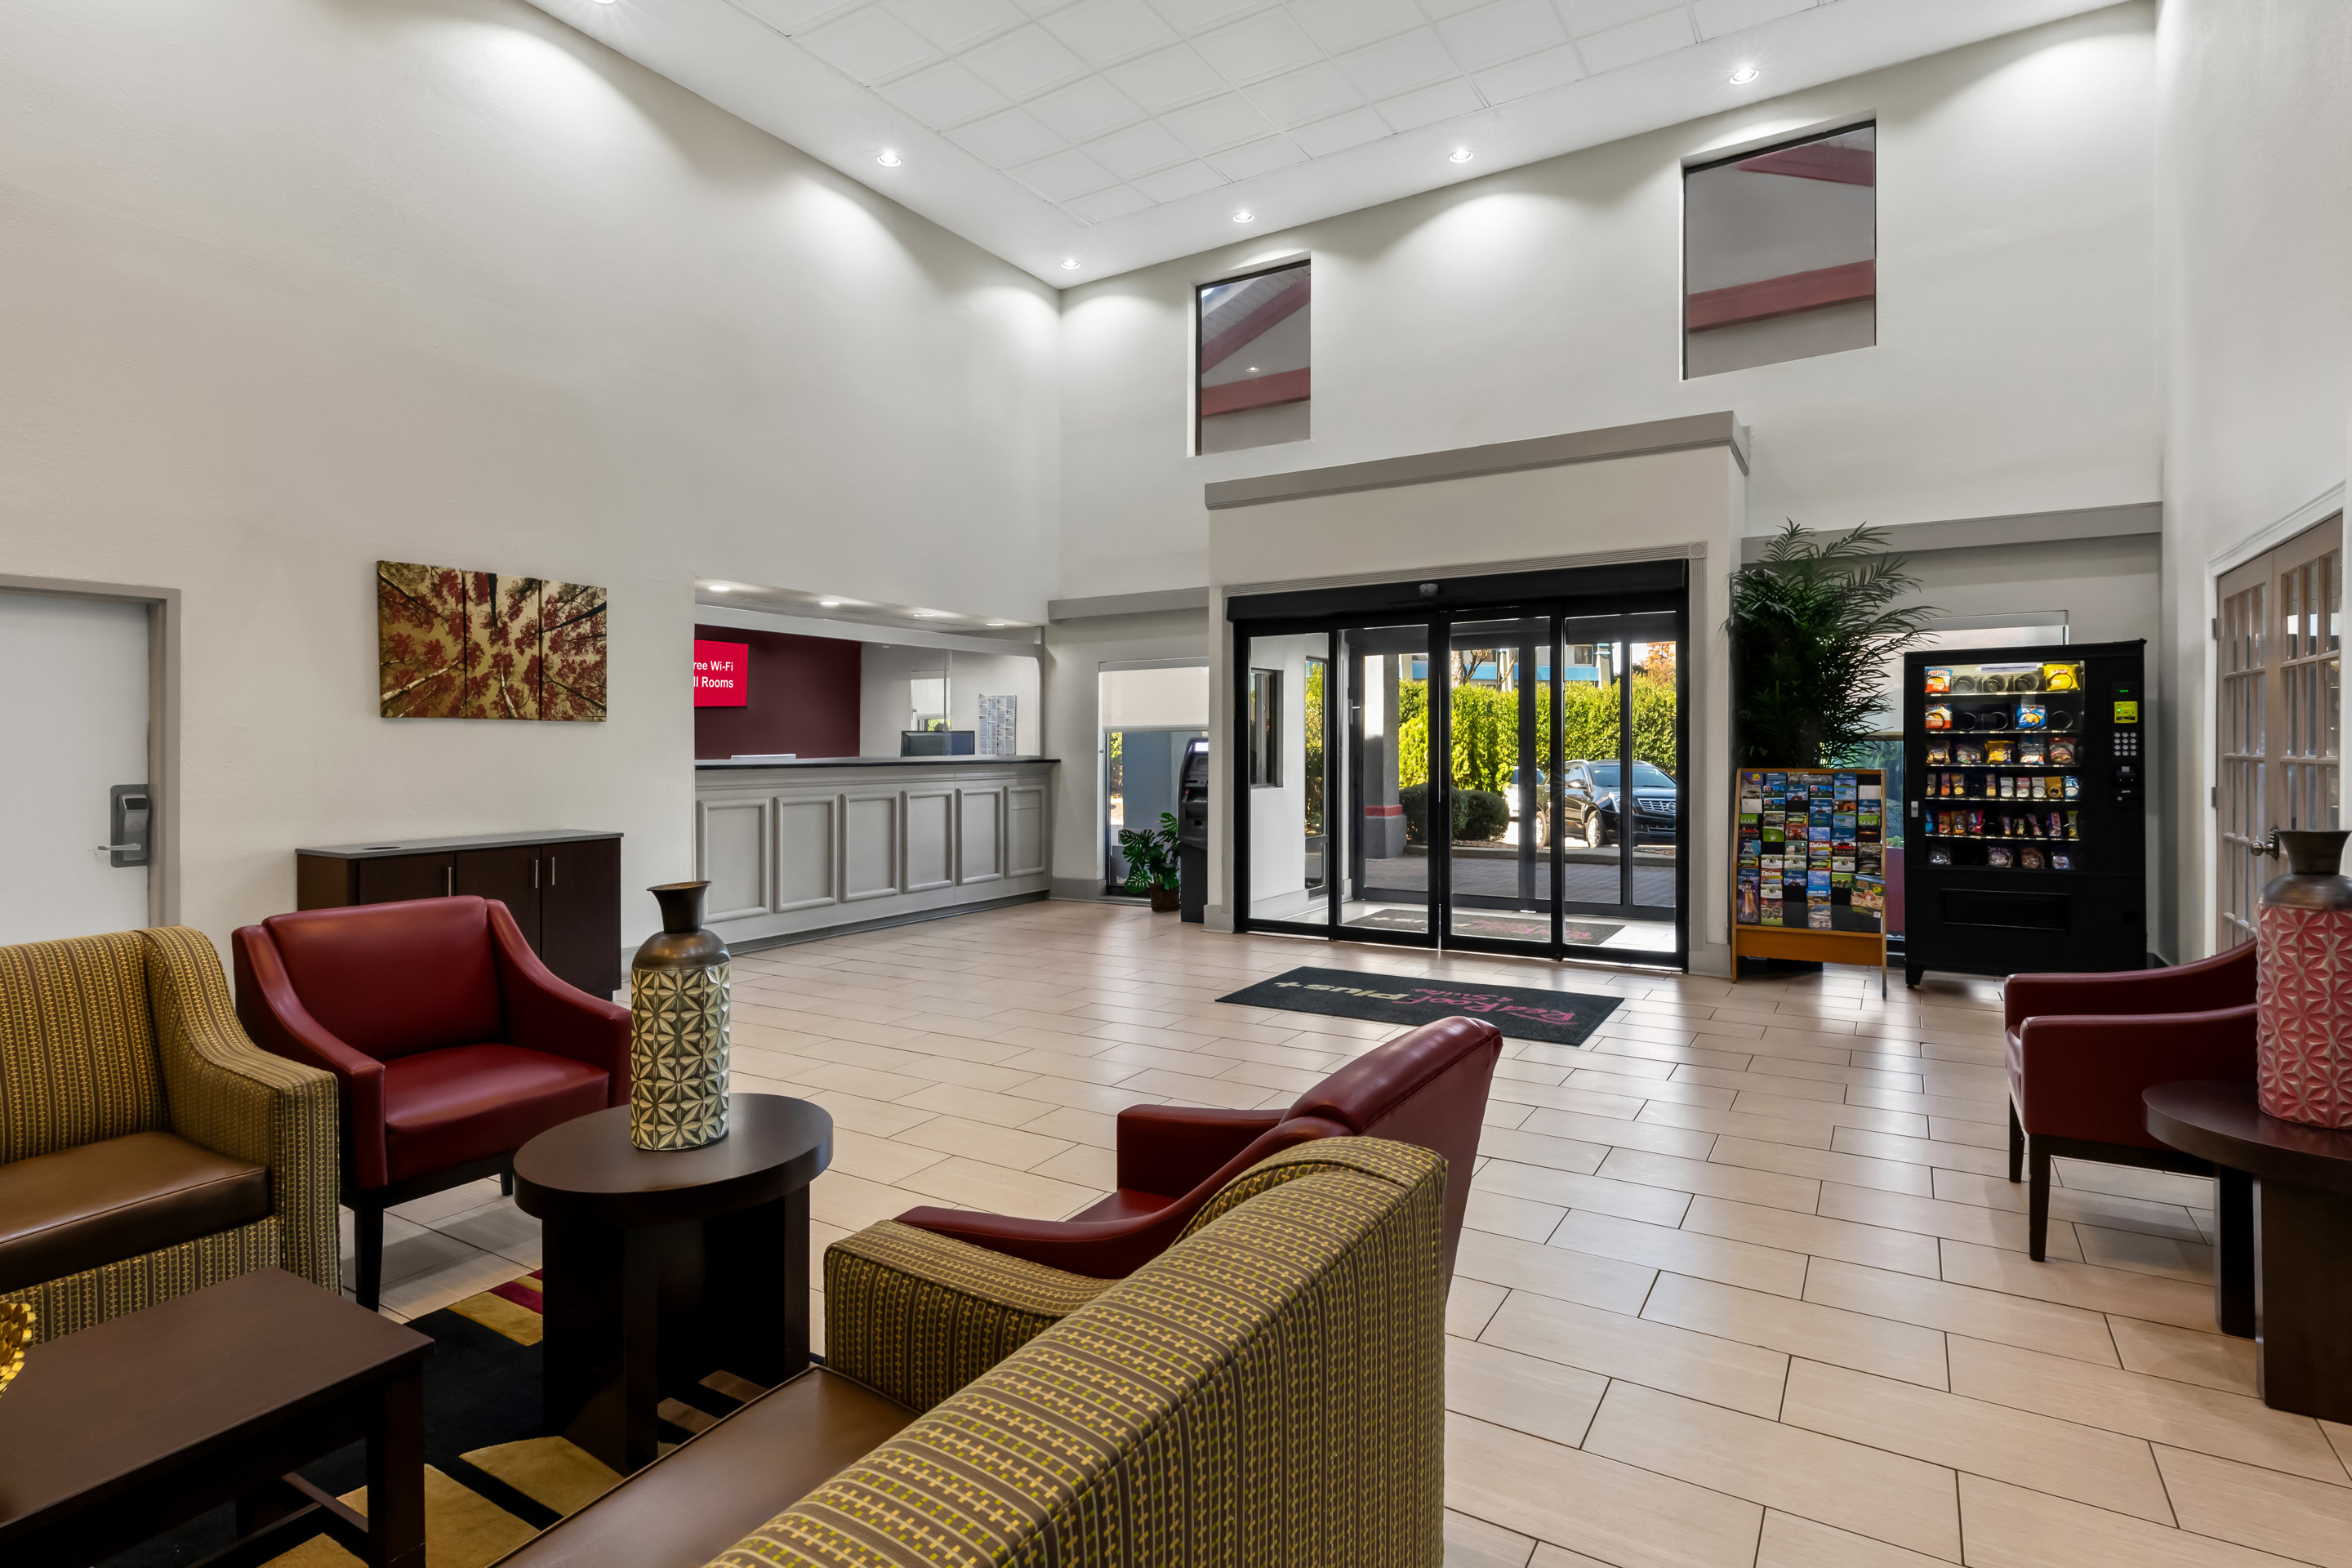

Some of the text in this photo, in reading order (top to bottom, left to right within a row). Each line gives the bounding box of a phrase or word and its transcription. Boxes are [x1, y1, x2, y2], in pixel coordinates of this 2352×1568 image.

[693, 660, 733, 671] ree Wi-Fi
[702, 676, 734, 688] Rooms
[1392, 995, 1500, 1013] Roof
[1494, 1004, 1577, 1022] Red
